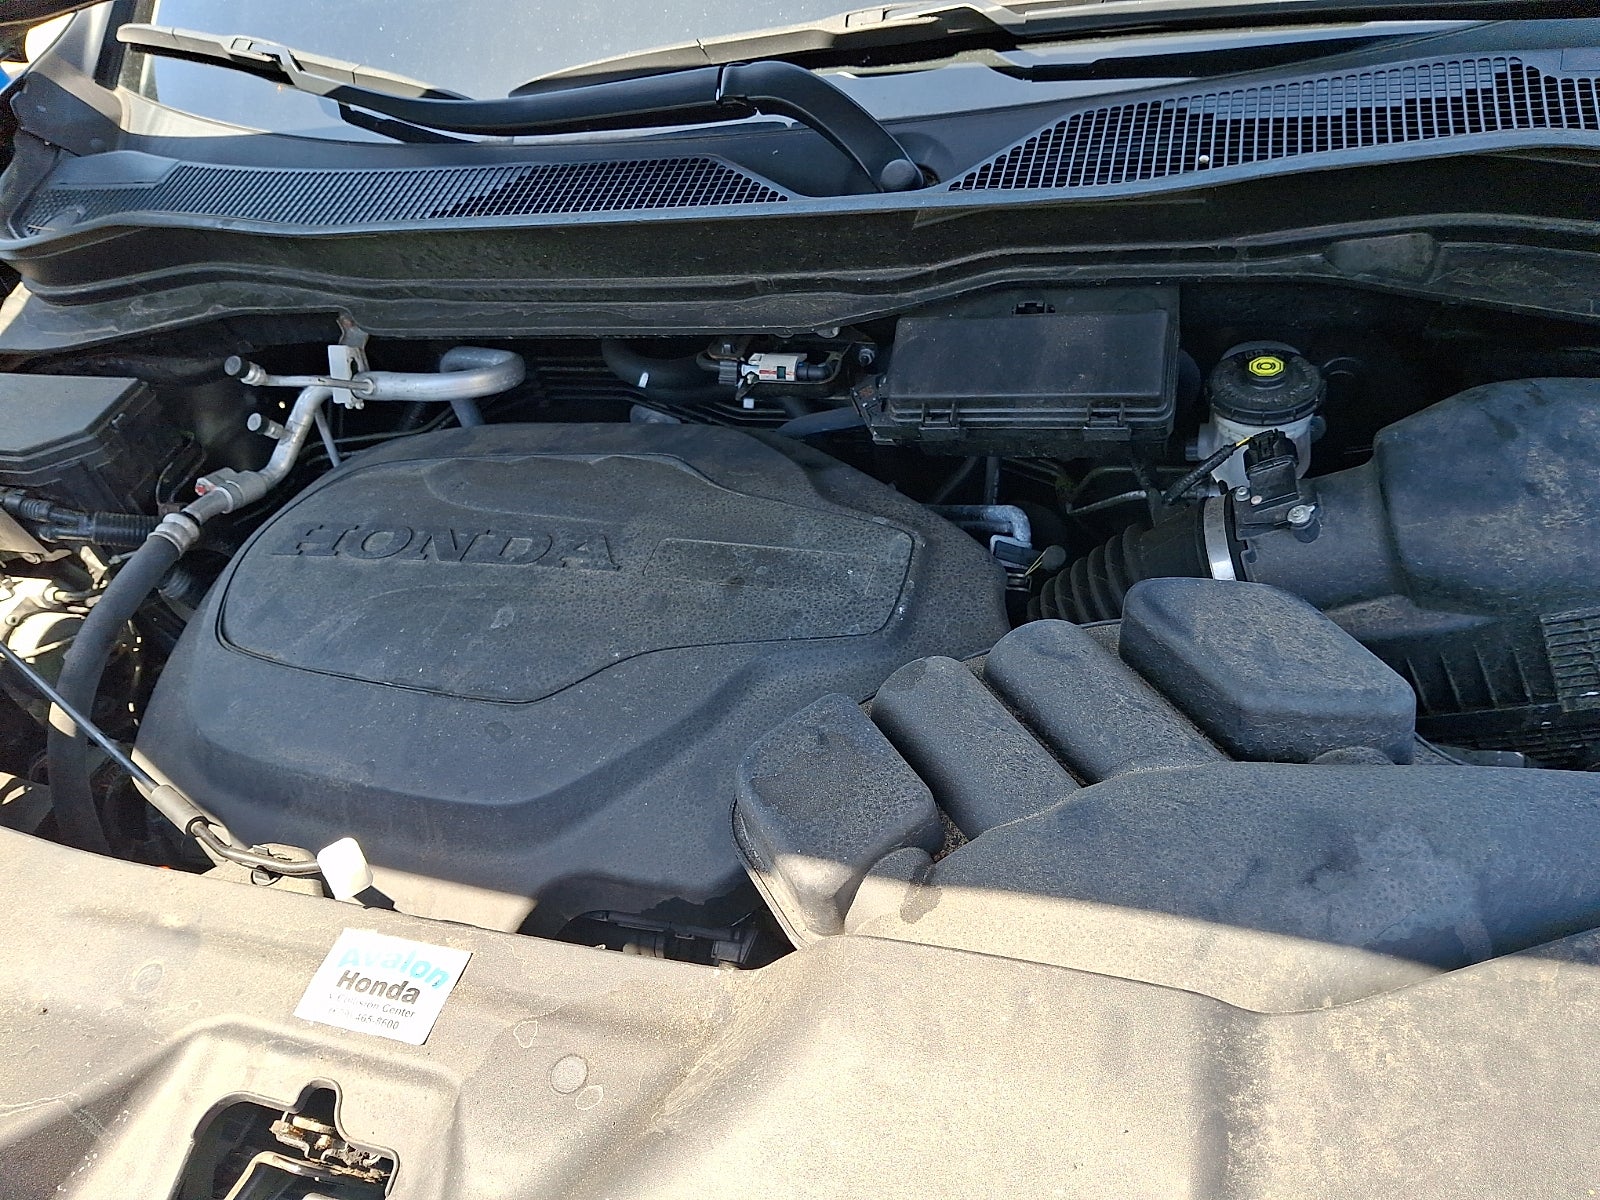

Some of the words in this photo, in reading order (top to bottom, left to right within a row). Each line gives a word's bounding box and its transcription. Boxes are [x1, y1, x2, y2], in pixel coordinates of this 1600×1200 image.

[271, 525, 621, 571] HONDA
[336, 969, 421, 1005] Honda
[338, 949, 450, 990] Avalon
[382, 1003, 416, 1019] Center
